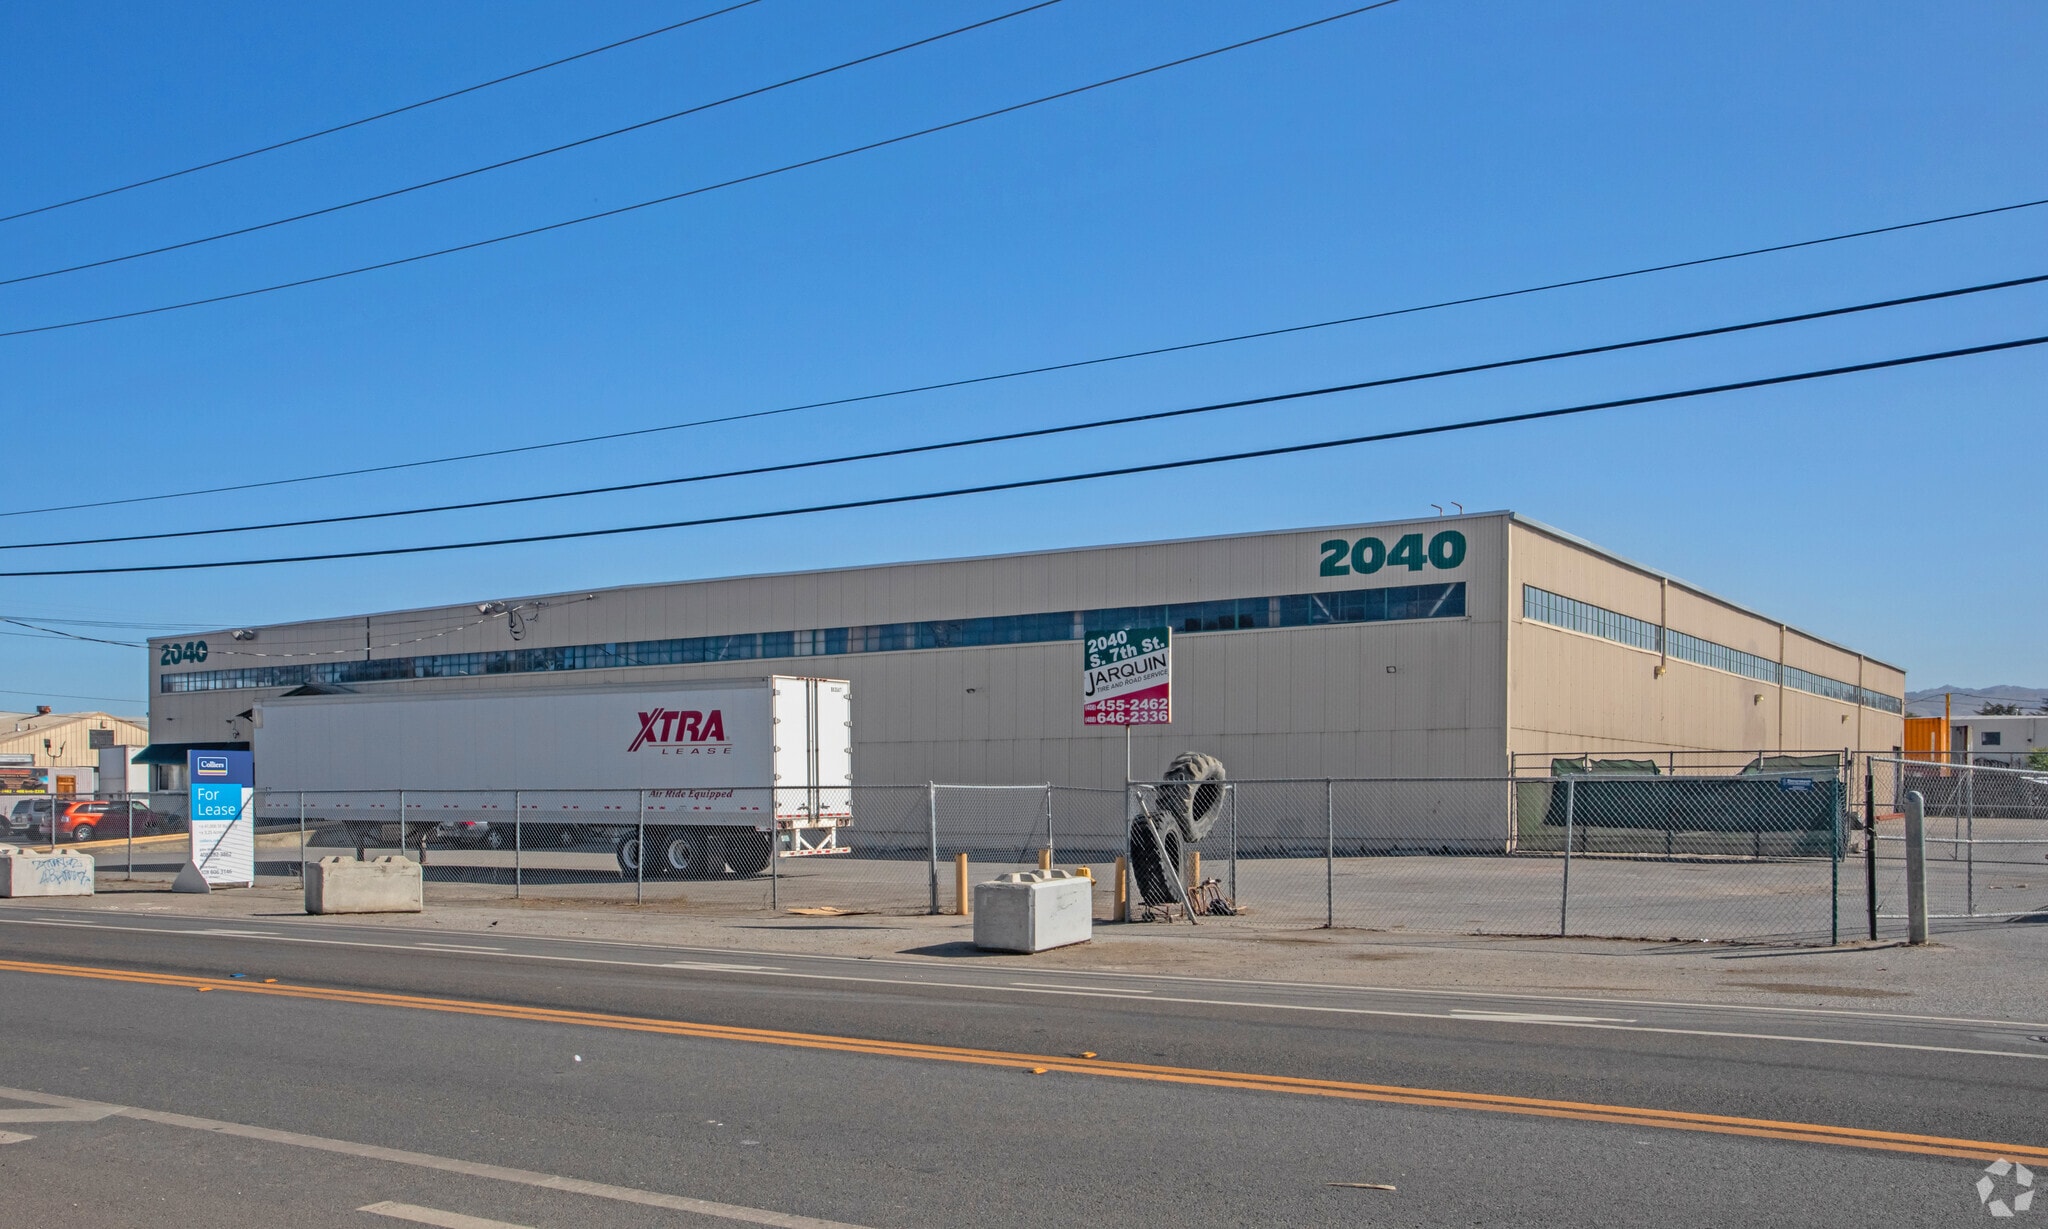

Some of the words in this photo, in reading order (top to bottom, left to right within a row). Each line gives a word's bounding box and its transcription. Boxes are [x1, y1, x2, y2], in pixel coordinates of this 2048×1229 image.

[1320, 530, 1467, 577] 2040
[1087, 630, 1128, 654] 2040
[160, 640, 208, 666] 2040
[1089, 653, 1106, 668] S.
[1109, 644, 1138, 662] 7th
[1141, 636, 1165, 653] St.
[1085, 653, 1168, 697] JARQUIN
[1096, 684, 1110, 693] TIRE
[1111, 681, 1124, 690] AND
[1125, 676, 1142, 686] ROAD
[1143, 669, 1168, 681] SERVICE
[1096, 698, 1168, 711] 455-2462
[1096, 711, 1168, 724] 646-2336
[627, 708, 725, 752] XTRA
[661, 747, 733, 755] LEASE
[200, 760, 225, 769] Colliers
[198, 787, 220, 801] For
[648, 789, 663, 798] Air
[665, 789, 686, 798] Ride
[688, 788, 734, 800] Equipped
[198, 803, 236, 816] Lease
